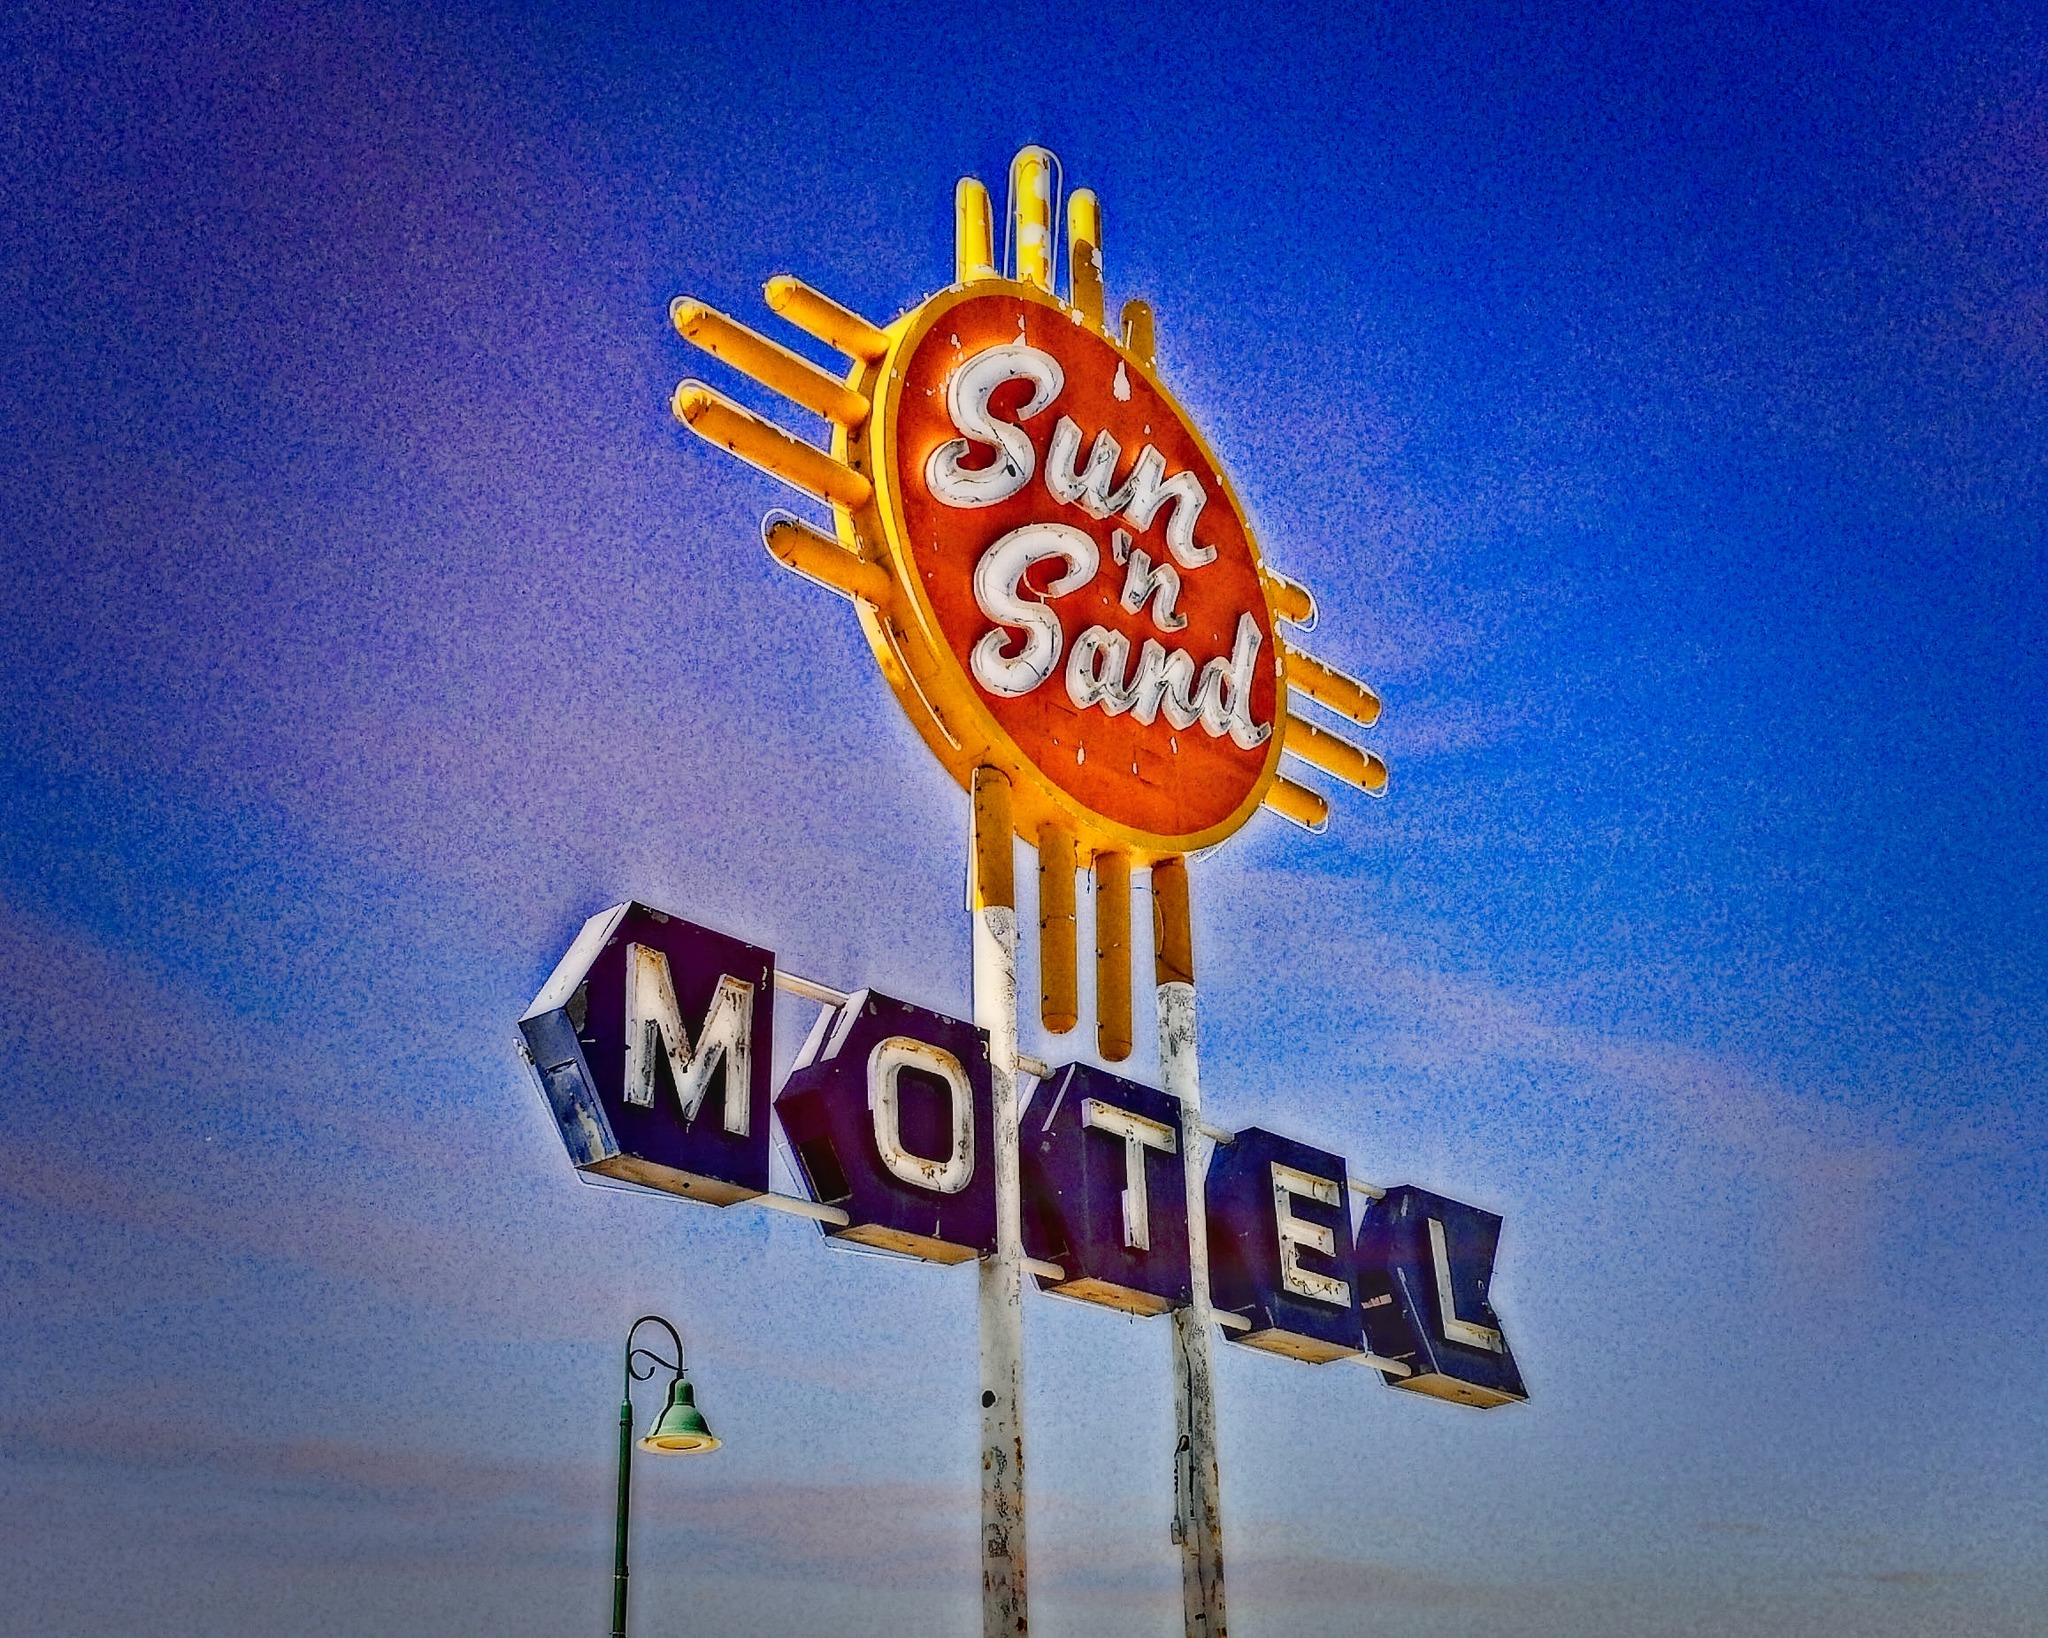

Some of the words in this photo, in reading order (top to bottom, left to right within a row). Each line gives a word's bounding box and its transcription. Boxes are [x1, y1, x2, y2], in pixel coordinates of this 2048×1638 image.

[925, 344, 1217, 569] Sun
[970, 523, 1272, 750] Sand
[1112, 528, 1187, 633] 'n
[624, 942, 1503, 1353] MOTEL
